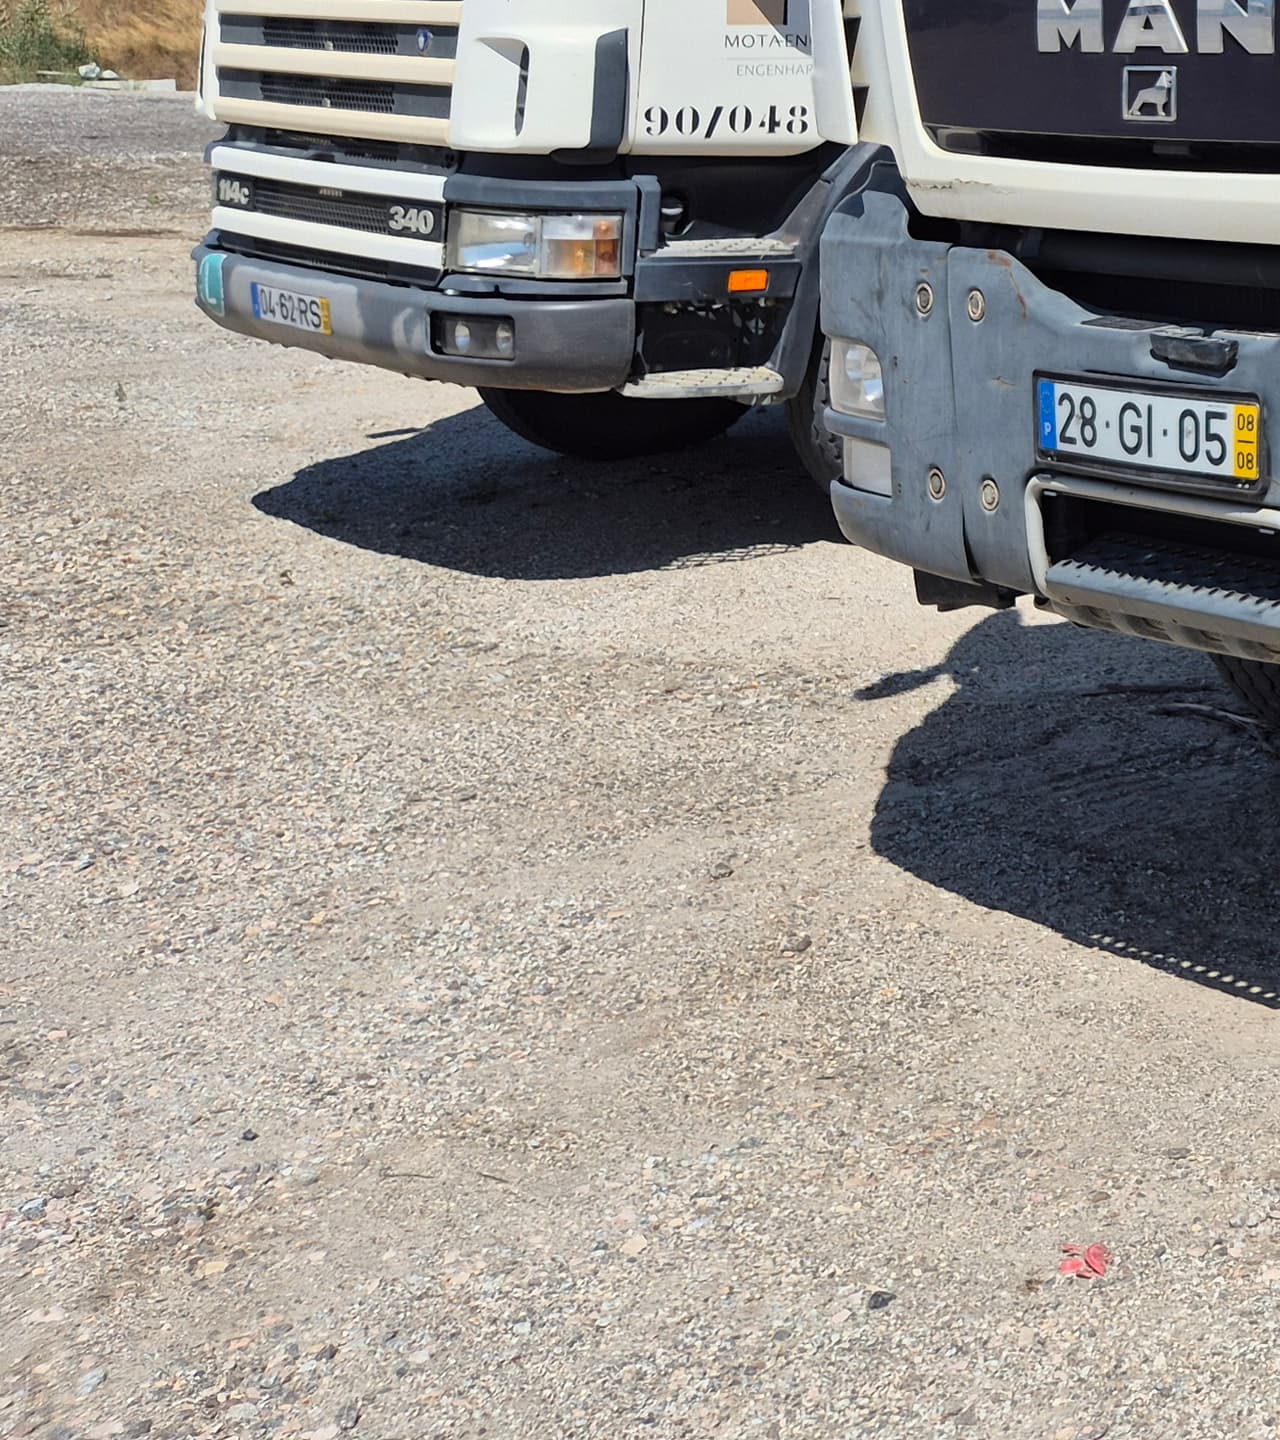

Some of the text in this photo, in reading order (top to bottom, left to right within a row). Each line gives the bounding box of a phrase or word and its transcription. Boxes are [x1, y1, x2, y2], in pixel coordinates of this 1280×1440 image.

[644, 105, 808, 139] 90/048
[388, 205, 435, 235] 340
[1236, 413, 1255, 432] 08
[1236, 451, 1255, 471] 08
